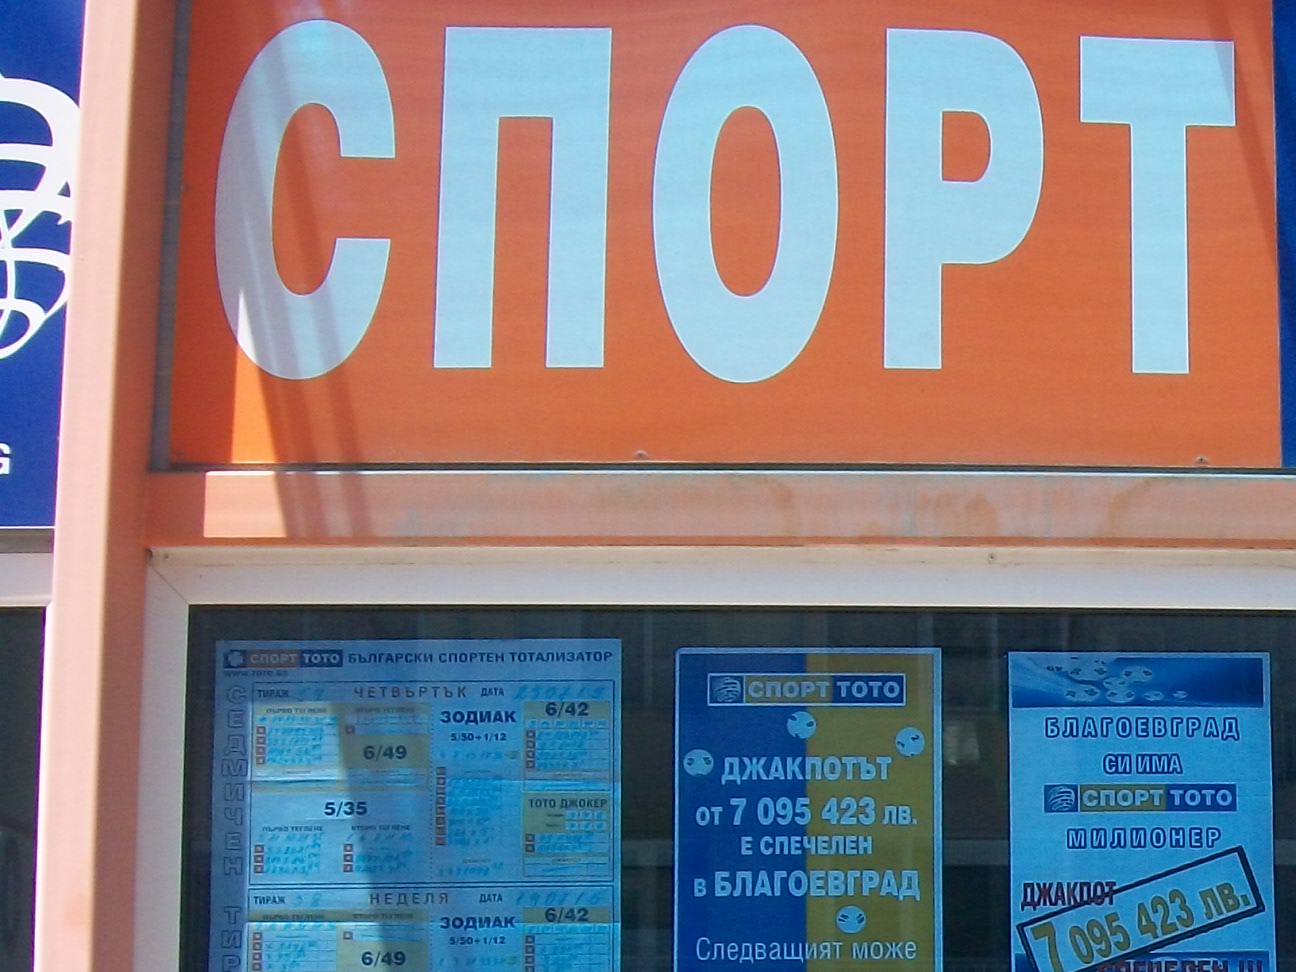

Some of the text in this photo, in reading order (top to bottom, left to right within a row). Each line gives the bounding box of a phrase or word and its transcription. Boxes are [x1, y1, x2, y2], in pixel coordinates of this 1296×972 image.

[215, 19, 1236, 383] СПОРТ
[250, 651, 613, 664] СПОРТ ТОТО БЪЛГАРСКИ СПОРТЕН ТОТАЛИЗАТОР
[257, 686, 505, 699] ТИРАЖ ЧЕТВЪРТЪК ДАТА
[748, 680, 900, 698] СПОРТ ТОТО
[440, 710, 517, 725] ЗОДИАК
[545, 702, 590, 717] 6/42
[1044, 716, 1240, 741] БЛАГОЕВГРАД
[363, 745, 407, 760] 6/49
[721, 756, 892, 785] ДЖАКПОТЪТ
[1103, 753, 1183, 774] СИ ИМА
[529, 799, 607, 809] ТОТО ДЖОКЕР
[1082, 788, 1232, 807] СПОРТ ТОТО
[324, 801, 367, 817] 5/35
[695, 806, 723, 826] от
[730, 797, 747, 826] 7
[756, 797, 811, 826] 095
[821, 797, 876, 826] 423
[741, 836, 872, 856] Е СПЕЧЕЛЕН
[1067, 827, 1221, 849] МИЛИОНЕР
[714, 870, 921, 901] БЛАГОЕВГРАД
[253, 893, 503, 906] ТИРАЖ НЕДЕЛЯ ДАТА
[1021, 881, 1117, 910] ДЖАКПОТ
[440, 916, 516, 930] ЗОДИАК
[545, 907, 590, 923] 6/42
[1069, 911, 1131, 965] 095
[1137, 889, 1194, 939] 423
[361, 951, 406, 967] 6/49
[695, 937, 917, 964] Следващият може
